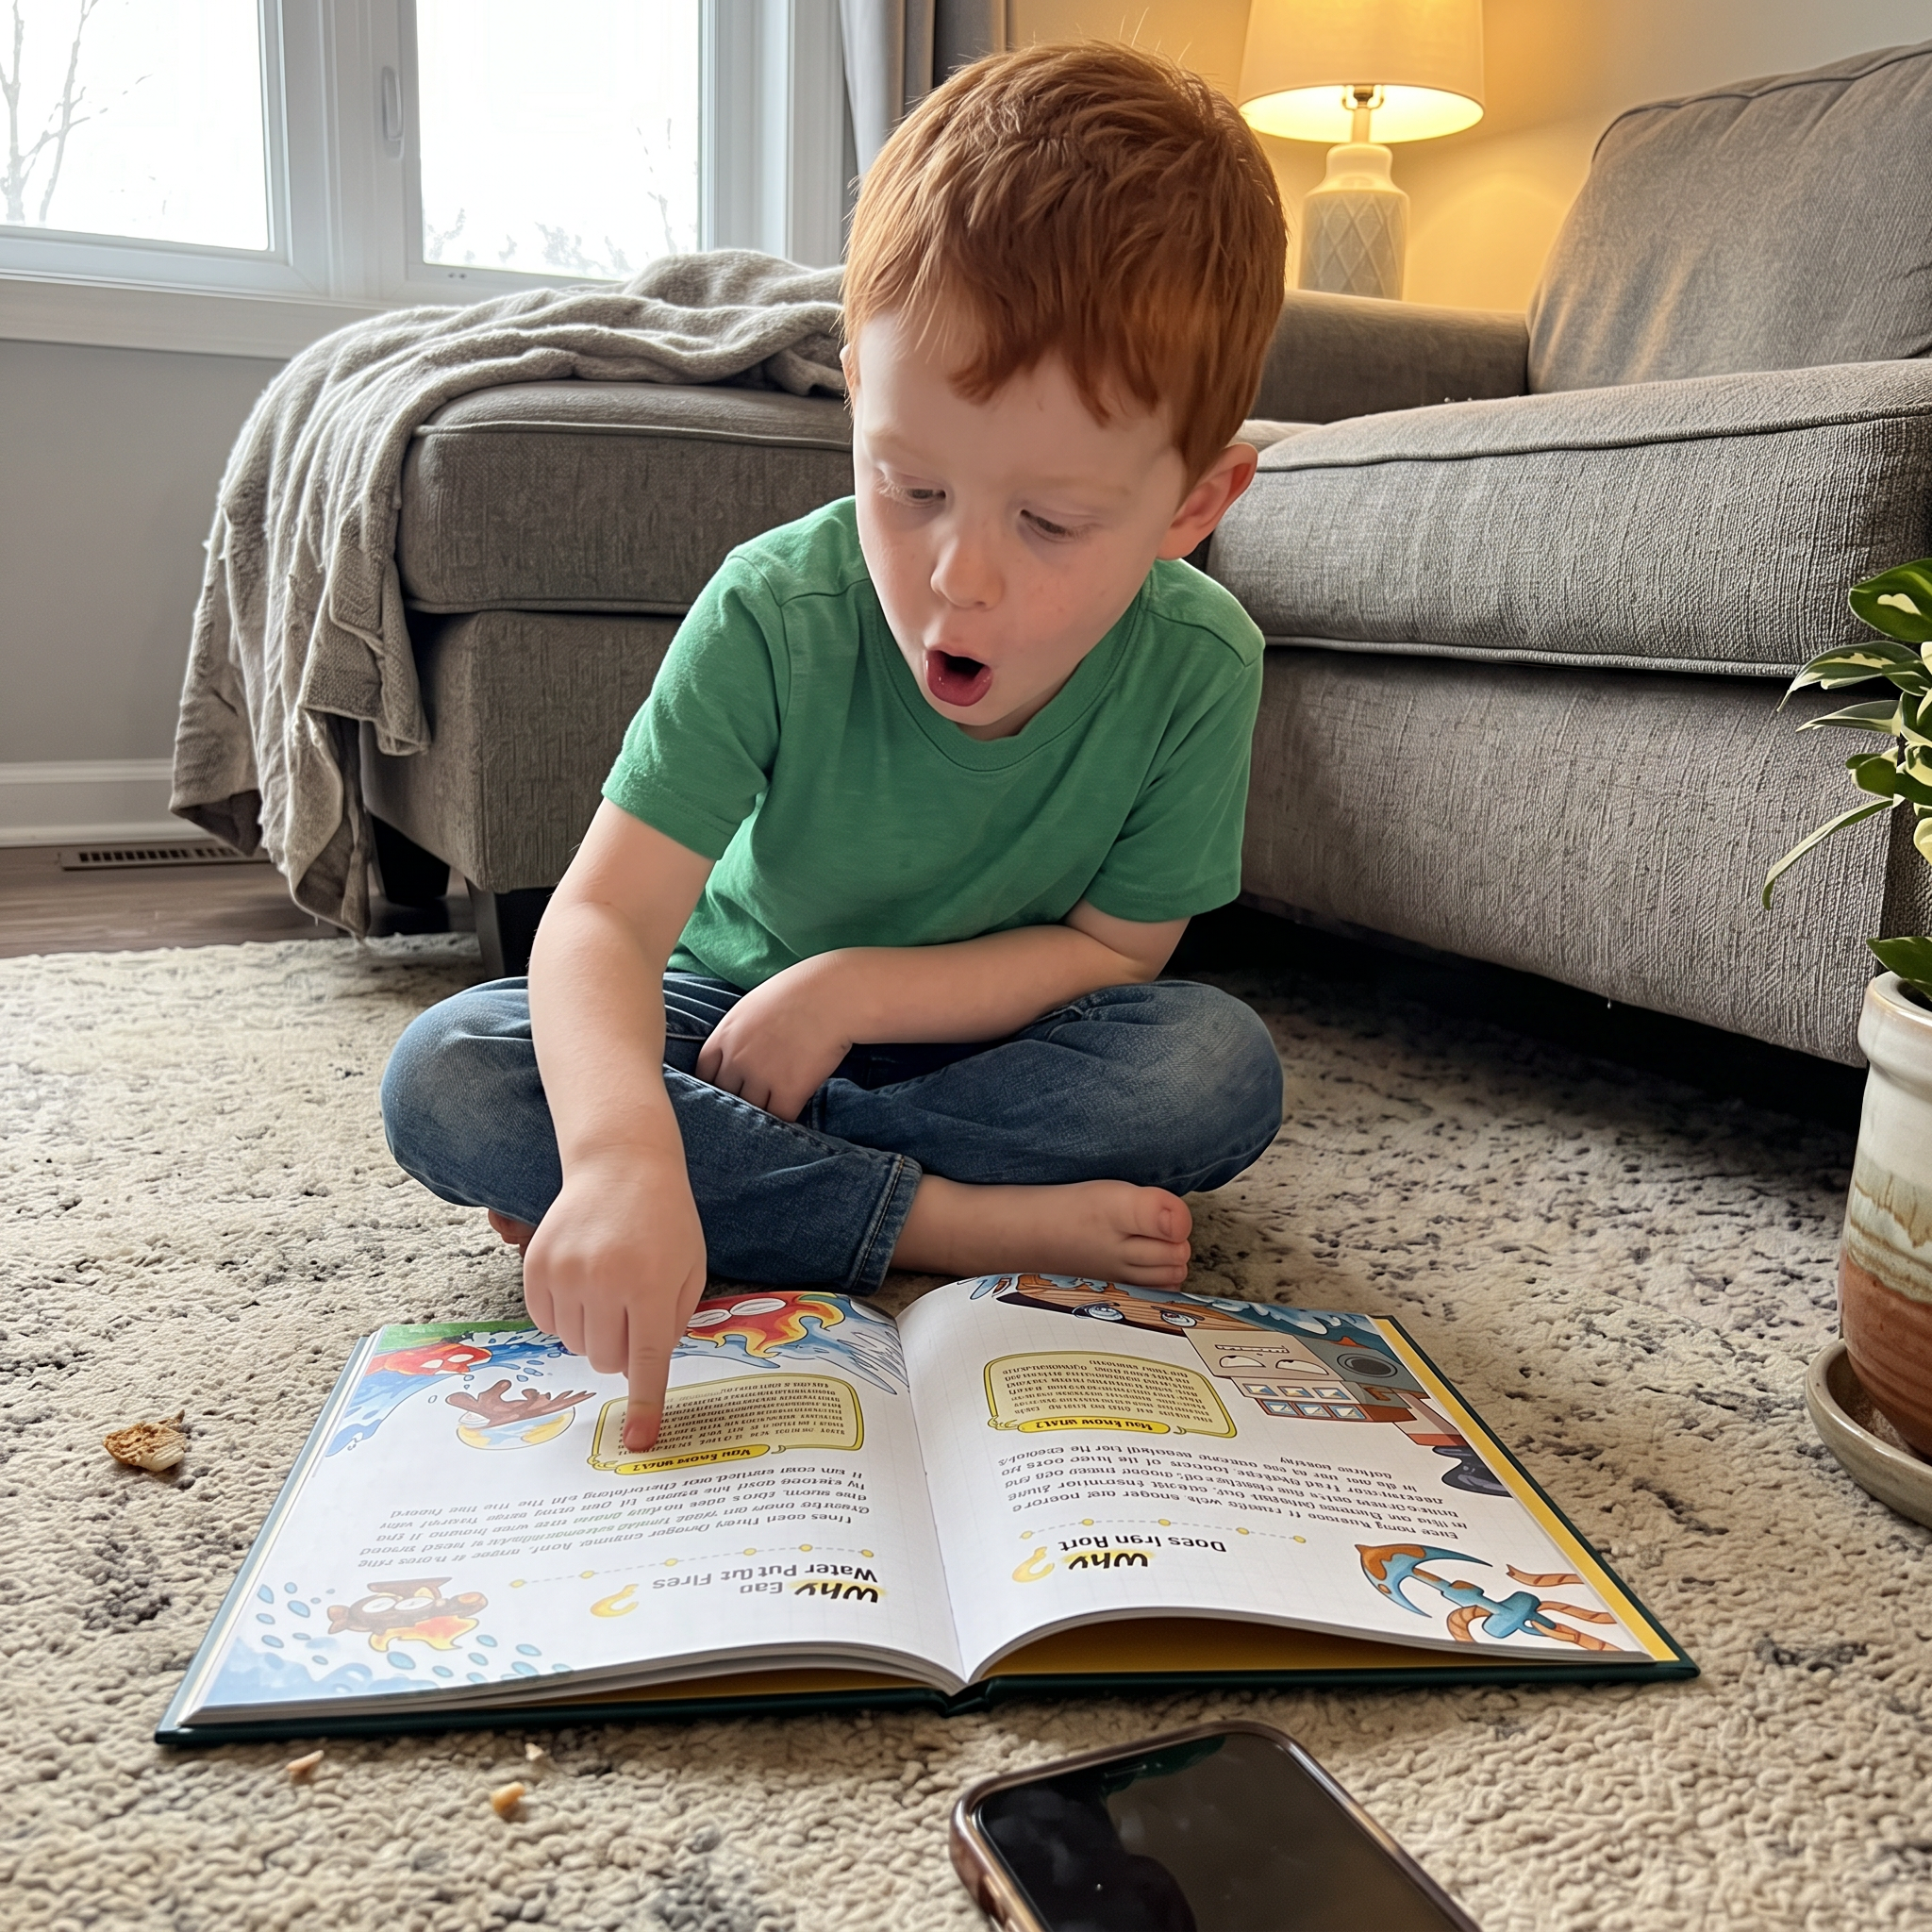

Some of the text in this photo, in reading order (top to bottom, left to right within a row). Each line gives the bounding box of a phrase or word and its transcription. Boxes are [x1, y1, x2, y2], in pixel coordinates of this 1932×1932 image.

[1167, 1537, 1226, 1553] Does
[758, 1564, 797, 1577] Put
[805, 1564, 878, 1583] Water
